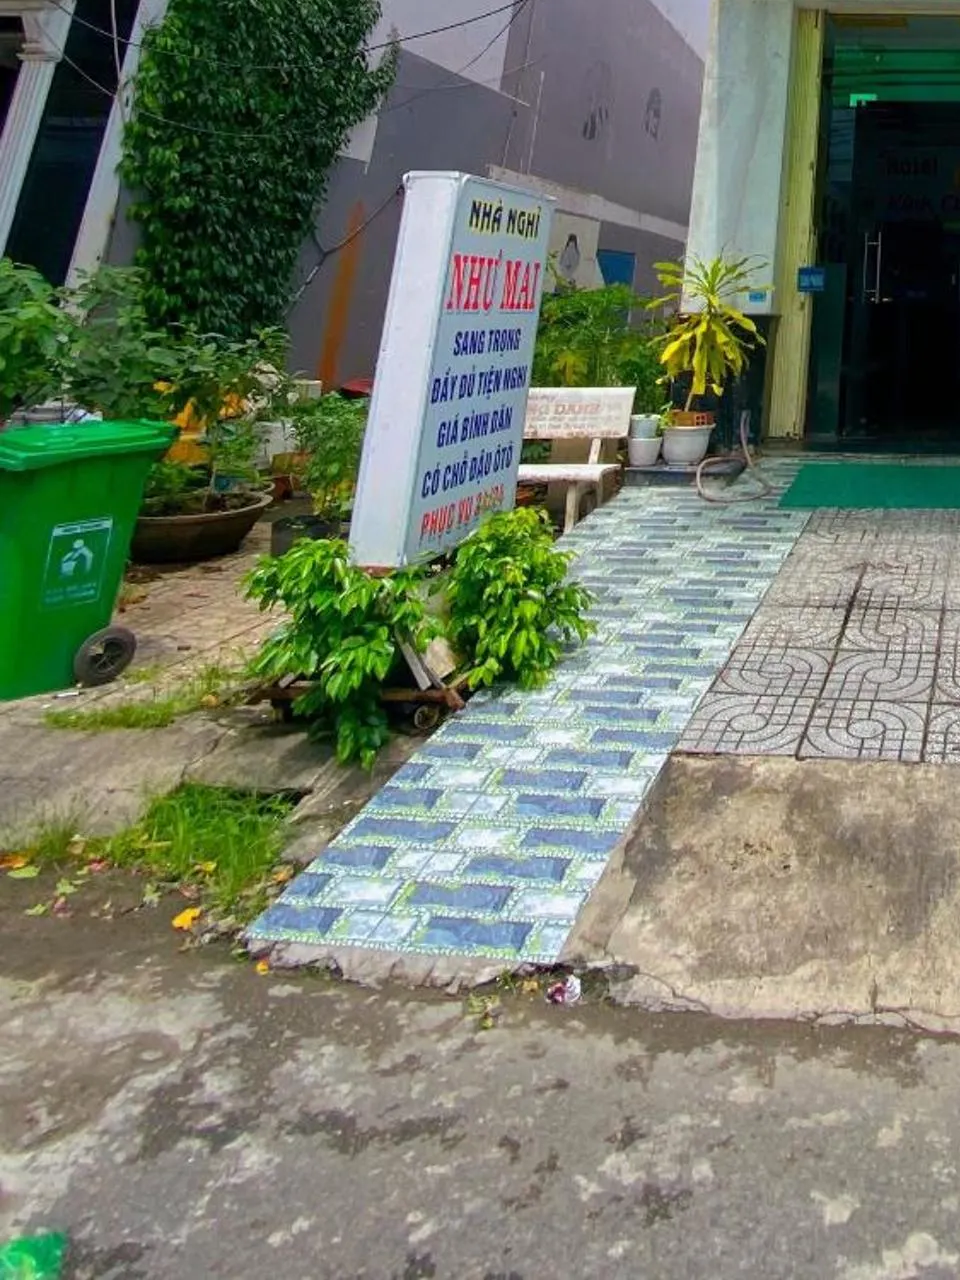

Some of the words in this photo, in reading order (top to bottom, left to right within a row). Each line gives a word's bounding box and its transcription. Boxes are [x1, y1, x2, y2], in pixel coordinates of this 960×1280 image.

[499, 259, 542, 311] MAI
[453, 329, 487, 357] SANG
[486, 327, 522, 358] TRỌNG
[477, 364, 503, 400] TIỆN
[436, 412, 461, 449] GIÁ
[421, 461, 442, 499] CÓ
